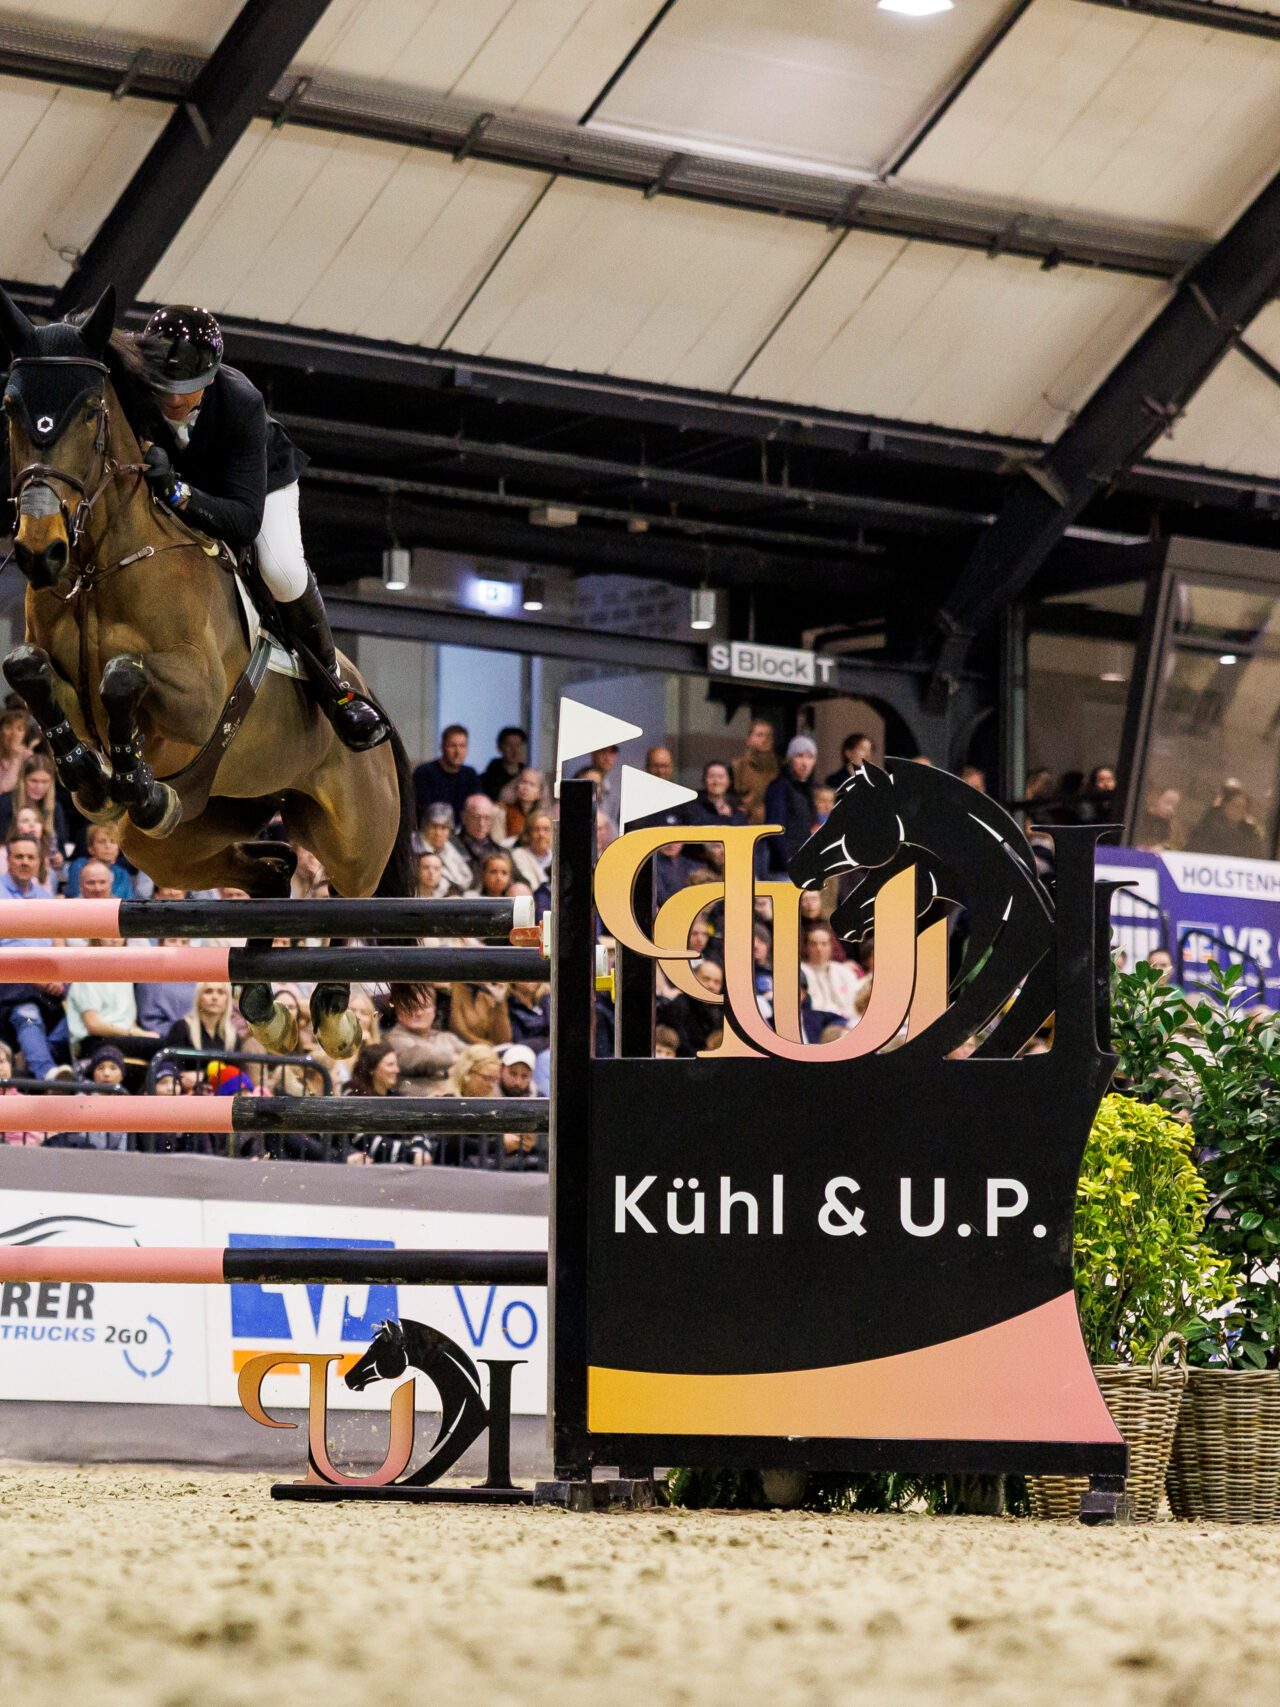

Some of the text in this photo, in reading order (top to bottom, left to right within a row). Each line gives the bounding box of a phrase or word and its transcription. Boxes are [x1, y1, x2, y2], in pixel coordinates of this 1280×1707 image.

[710, 644, 834, 683] S Block T
[614, 1174, 1048, 1239] Kühl & U.P.
[0, 1324, 97, 1343] TRUCKS
